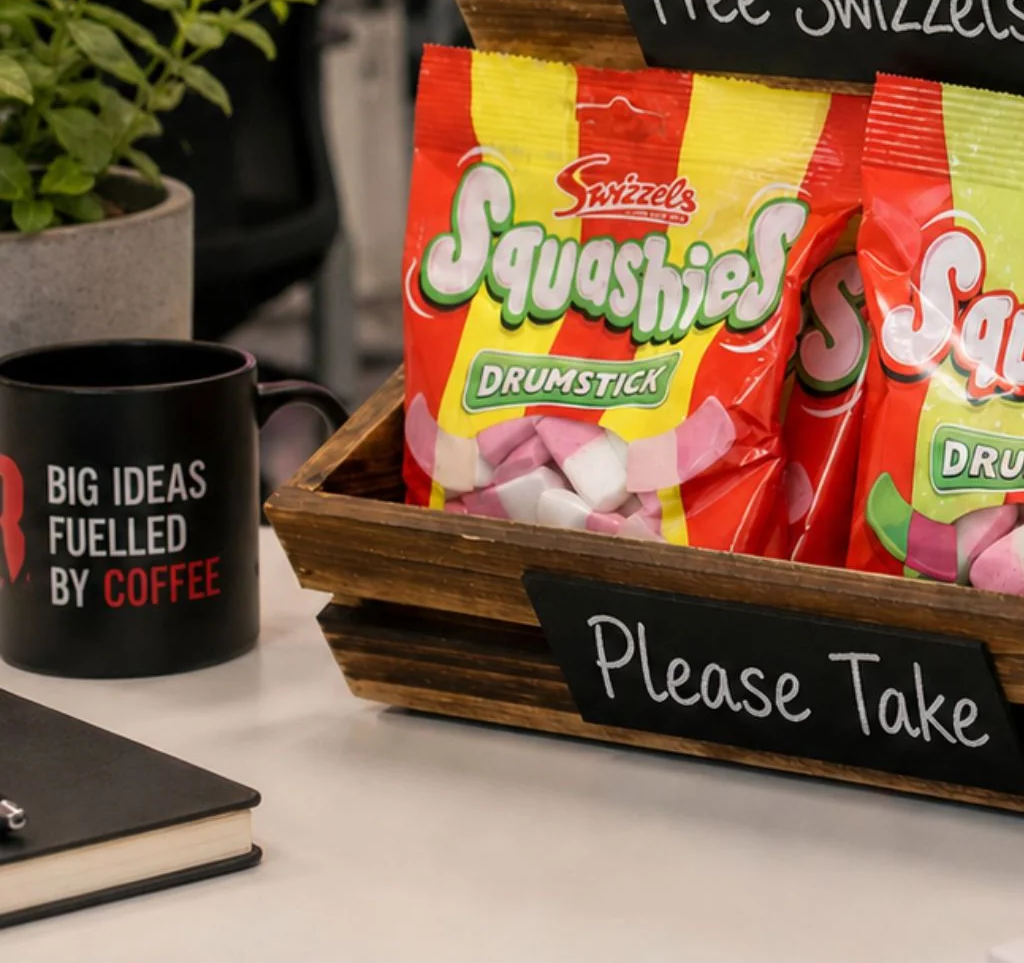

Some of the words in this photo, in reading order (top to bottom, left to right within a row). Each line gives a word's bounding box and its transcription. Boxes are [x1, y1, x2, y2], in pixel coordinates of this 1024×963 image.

[553, 153, 699, 218] Swizzels
[476, 362, 668, 400] DRUMSTICK
[47, 463, 99, 507] BIG
[113, 459, 208, 507] IDEAS
[49, 513, 188, 558] FUELLED
[50, 566, 90, 608] BY
[104, 556, 222, 609] COFFEE
[587, 614, 812, 723] Please
[828, 651, 990, 749] Take
